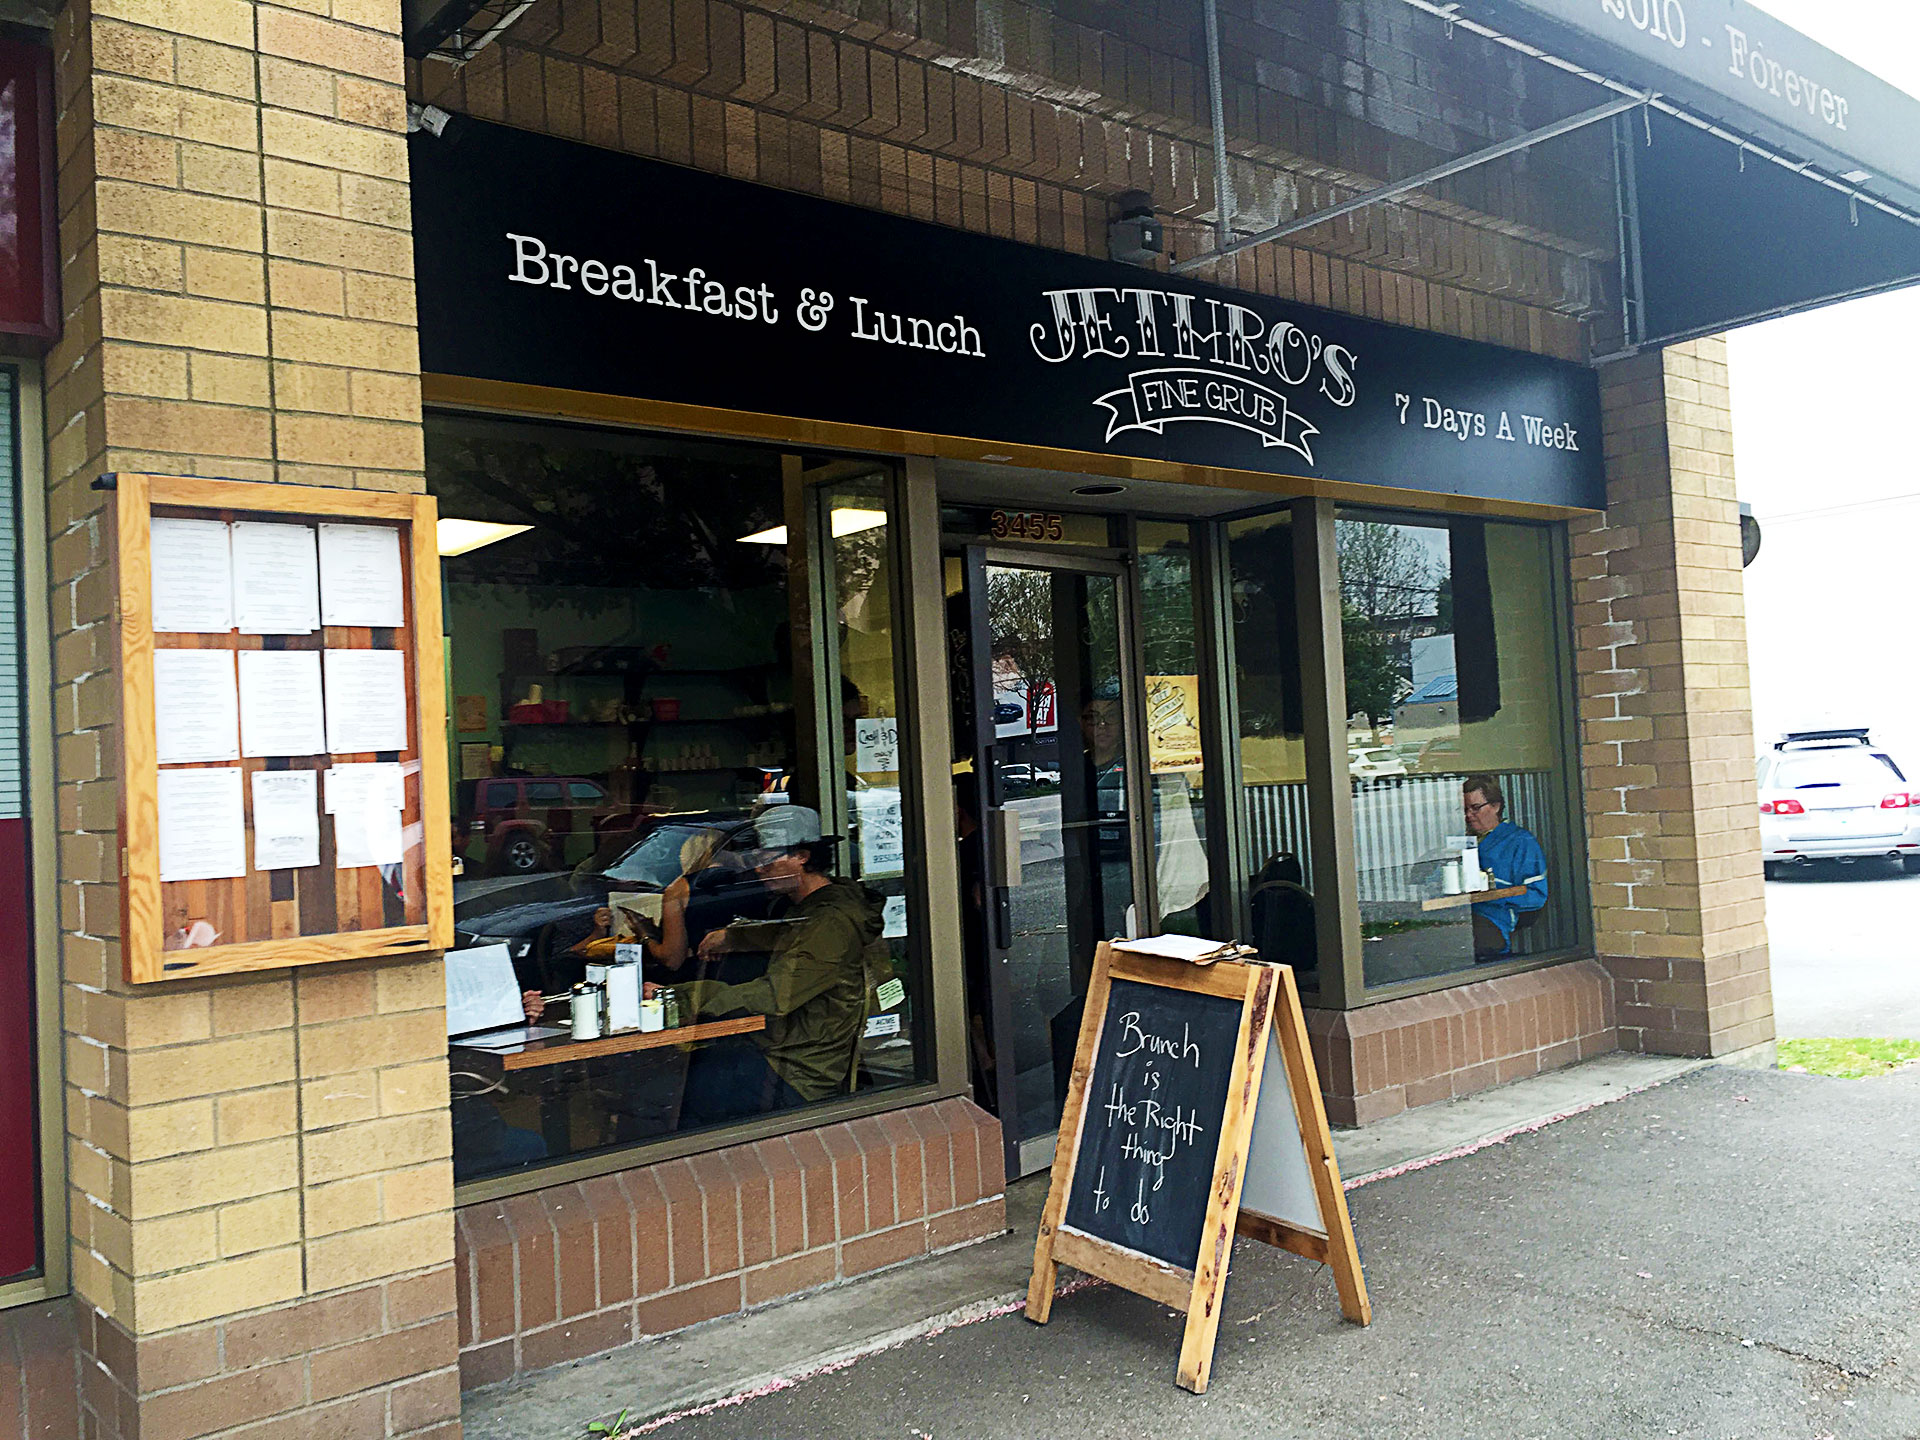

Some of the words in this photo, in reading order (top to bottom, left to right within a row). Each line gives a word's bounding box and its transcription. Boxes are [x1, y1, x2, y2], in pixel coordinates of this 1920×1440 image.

[1725, 23, 1848, 131] Forever
[506, 232, 779, 325] Breakfast
[797, 287, 835, 332] &
[849, 296, 987, 358] Lunch
[1029, 287, 1359, 407] JETHRO'S
[1141, 378, 1202, 412] FINE
[1204, 380, 1278, 427] GRUB
[1395, 392, 1411, 425] 7
[1423, 397, 1487, 441] Days
[1496, 411, 1516, 442] A
[1521, 414, 1580, 452] Week
[991, 511, 1063, 541] 3455
[1115, 1011, 1201, 1068] Brunch
[1143, 1060, 1161, 1091] is
[1104, 1082, 1137, 1128] the
[1137, 1099, 1204, 1160] Right
[1120, 1132, 1166, 1192] thing
[1093, 1165, 1110, 1215] to
[1130, 1178, 1151, 1225] do
